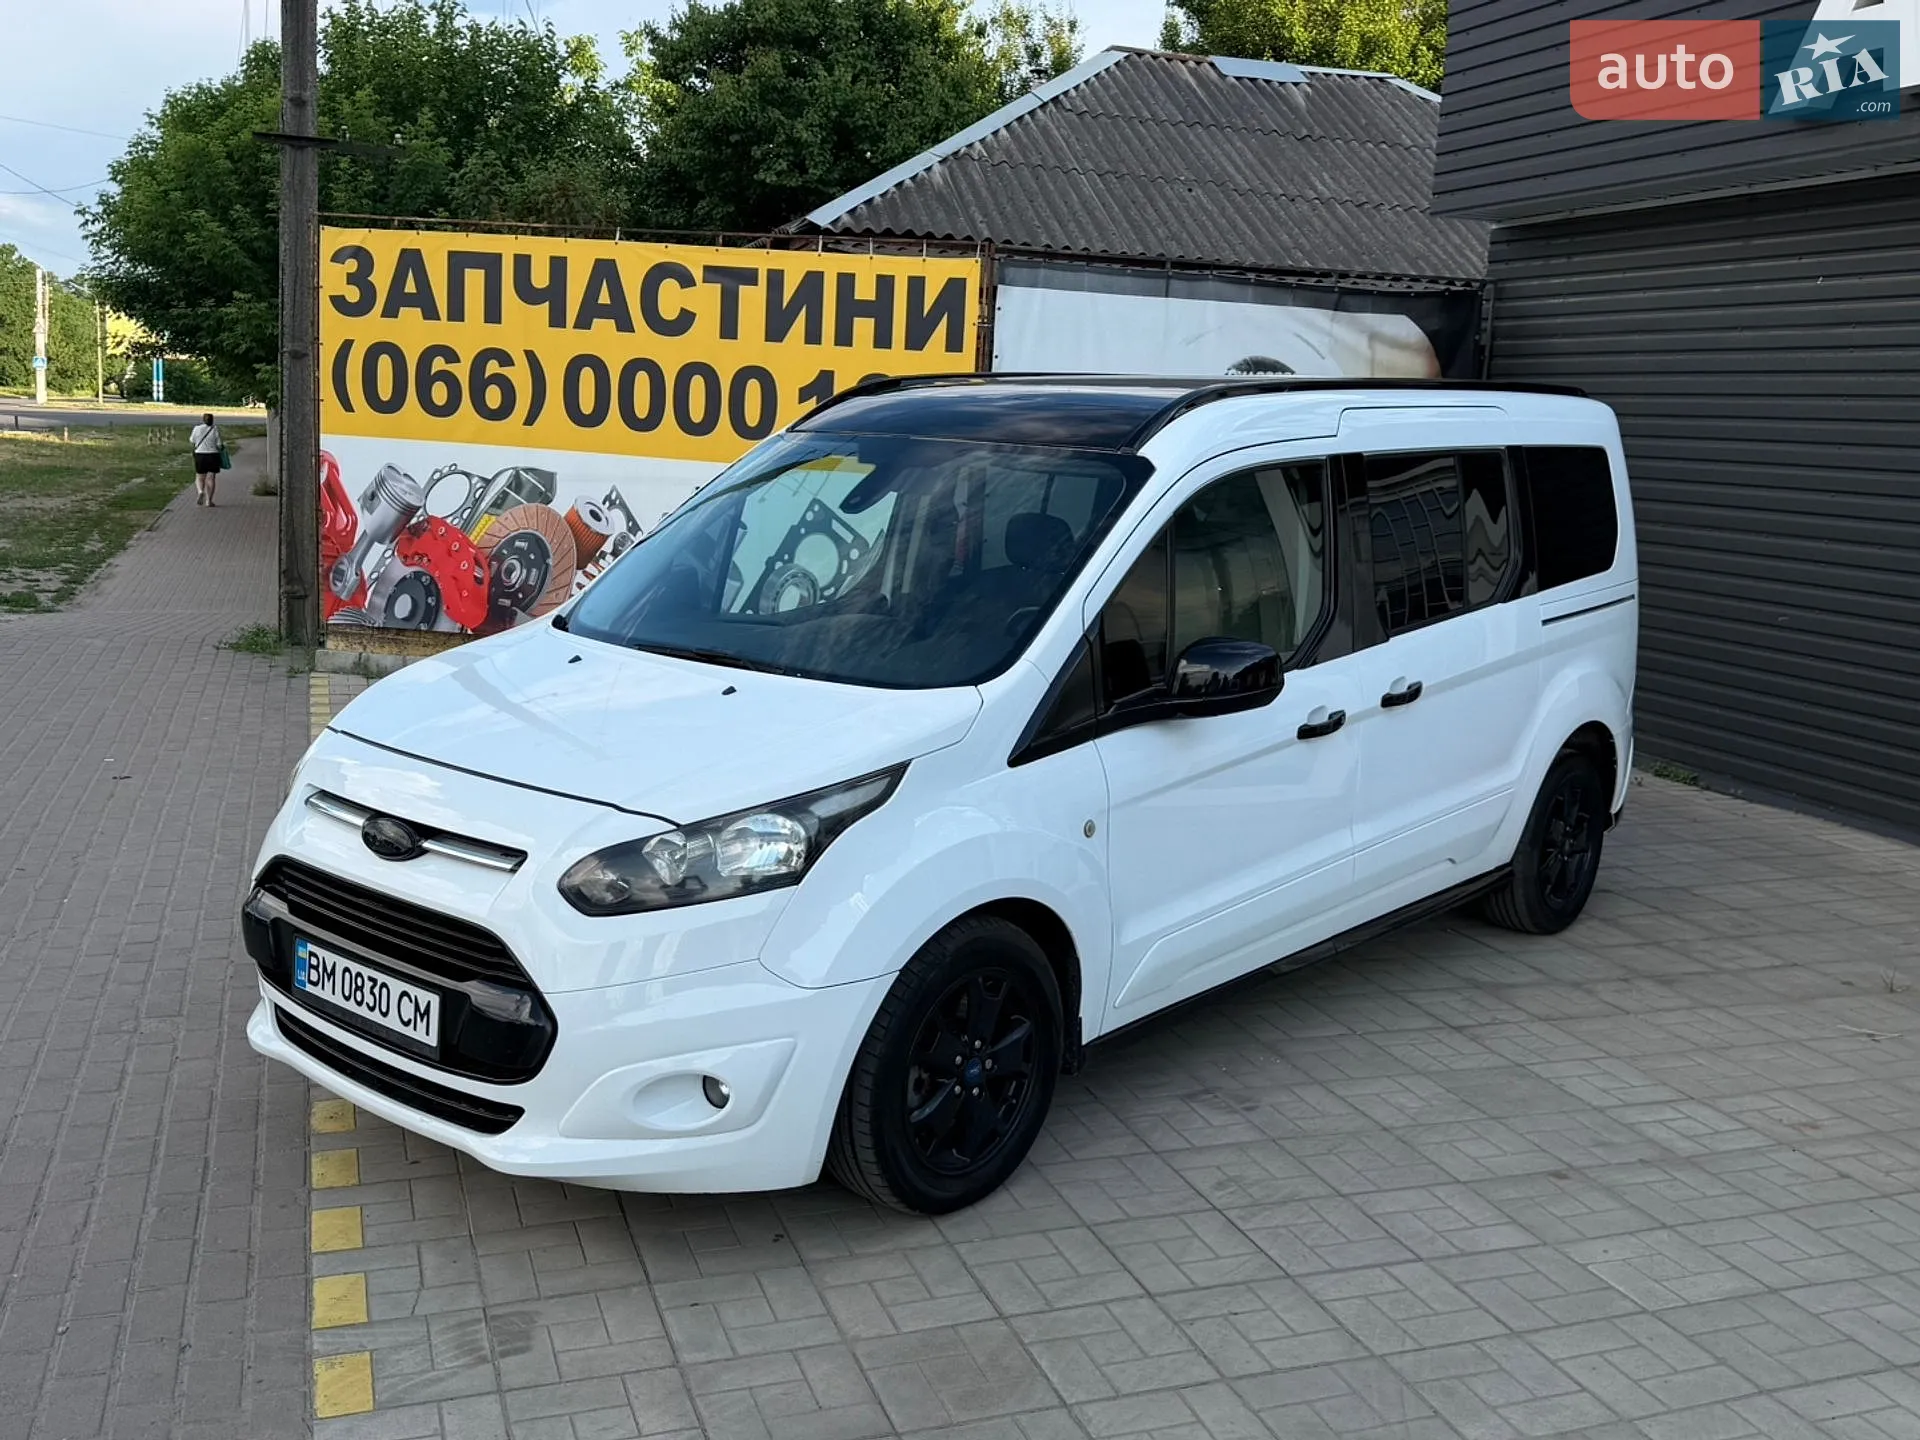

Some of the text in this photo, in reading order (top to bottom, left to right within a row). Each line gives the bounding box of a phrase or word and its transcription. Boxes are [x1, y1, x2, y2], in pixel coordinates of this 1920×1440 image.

[328, 245, 967, 353] ЗАПЧАСТИНИ
[307, 950, 431, 1037] BM 0830 CM
